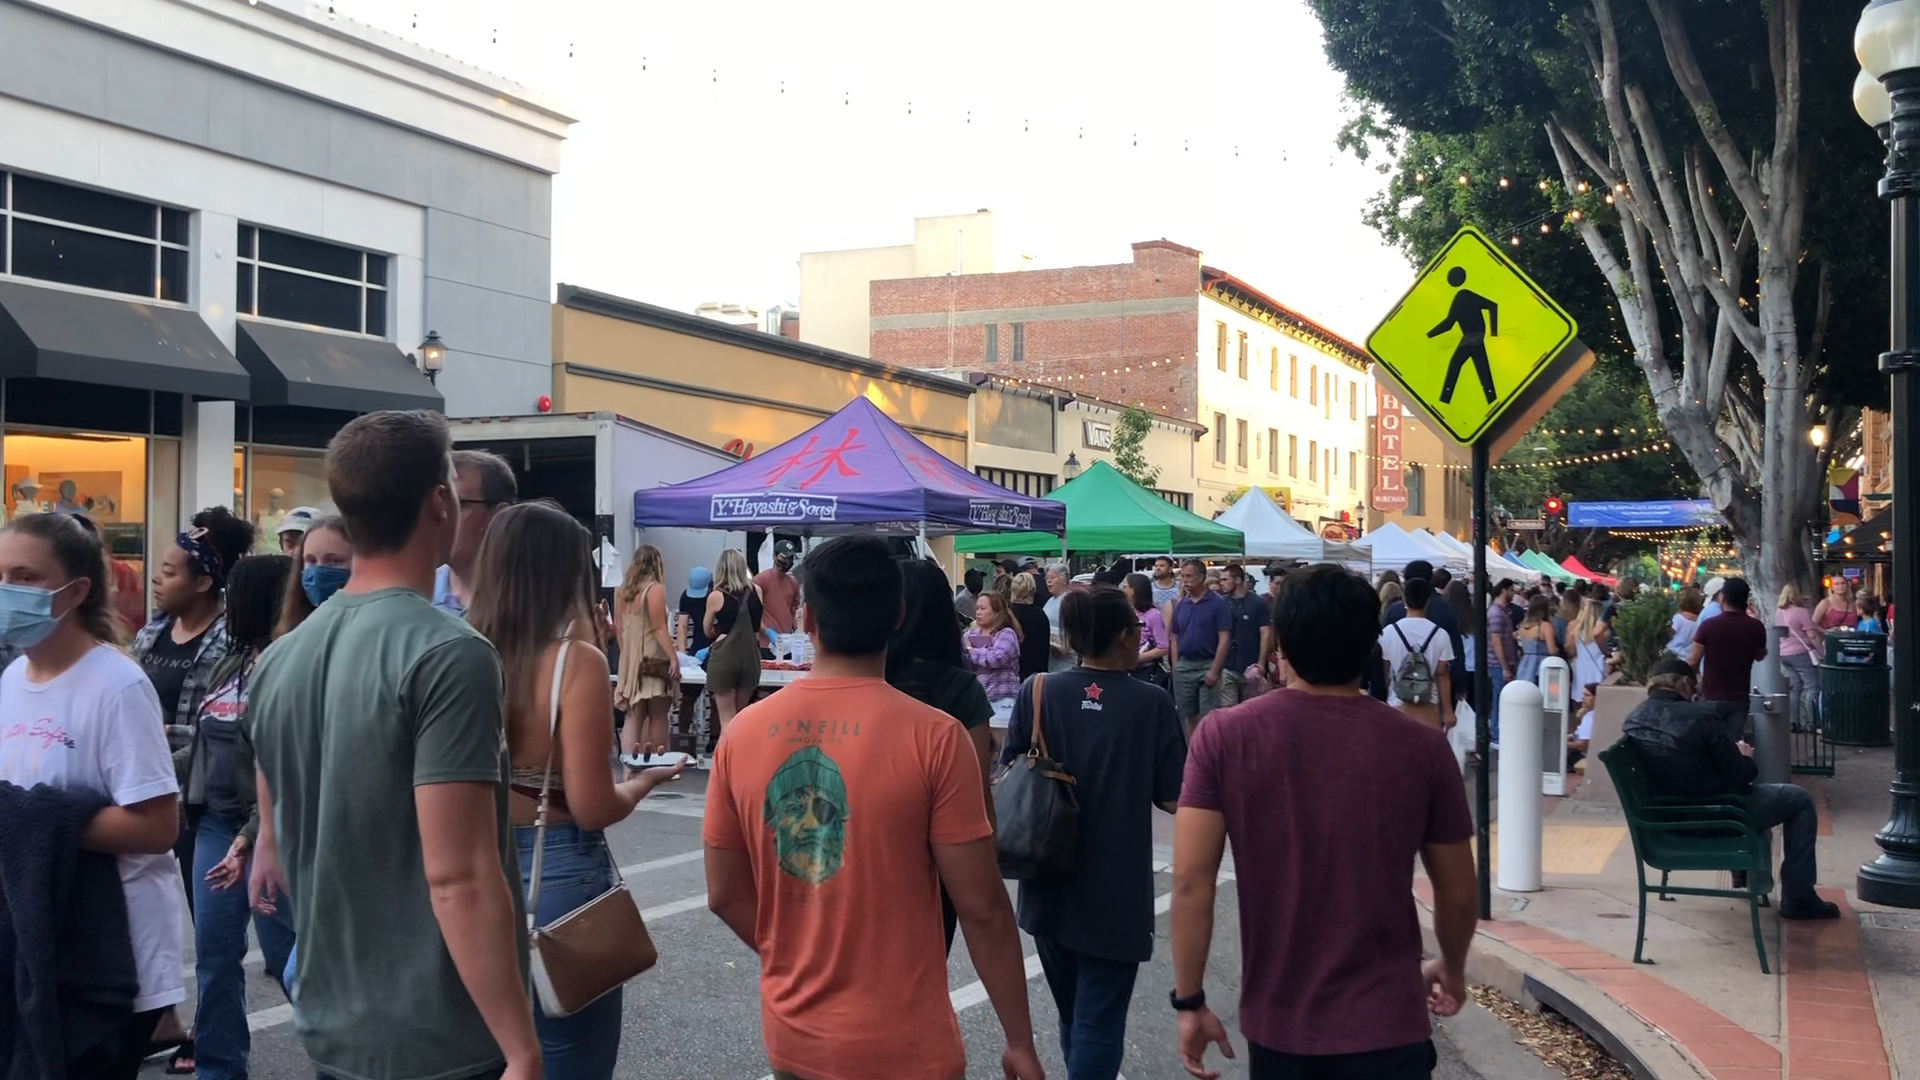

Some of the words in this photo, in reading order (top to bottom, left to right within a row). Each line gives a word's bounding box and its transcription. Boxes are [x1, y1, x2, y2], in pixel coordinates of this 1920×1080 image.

[1086, 420, 1111, 449] VANS
[1382, 394, 1400, 491] HOTEL
[767, 719, 860, 738] O'NEILL
